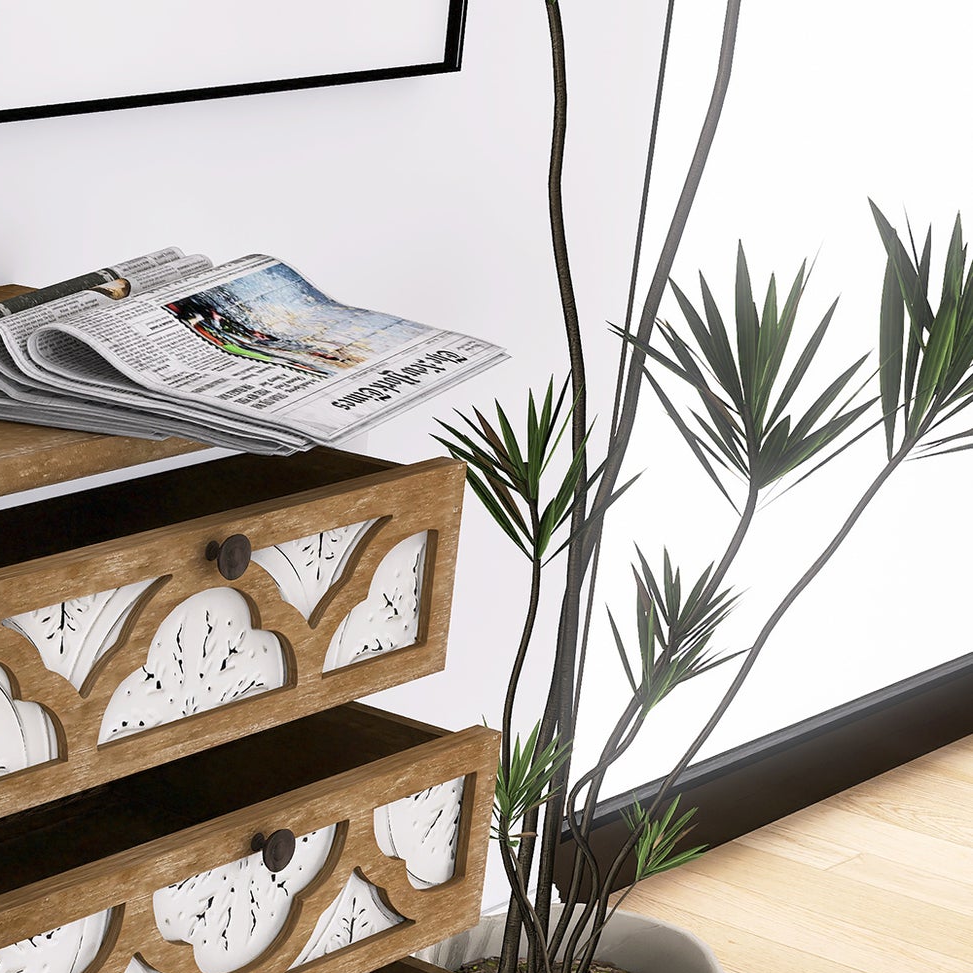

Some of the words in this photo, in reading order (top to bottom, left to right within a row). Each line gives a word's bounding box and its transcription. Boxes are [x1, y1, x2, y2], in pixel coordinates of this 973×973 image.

[400, 358, 447, 378] New
[424, 349, 468, 365] The
[368, 369, 421, 394] York
[330, 386, 393, 411] Times
